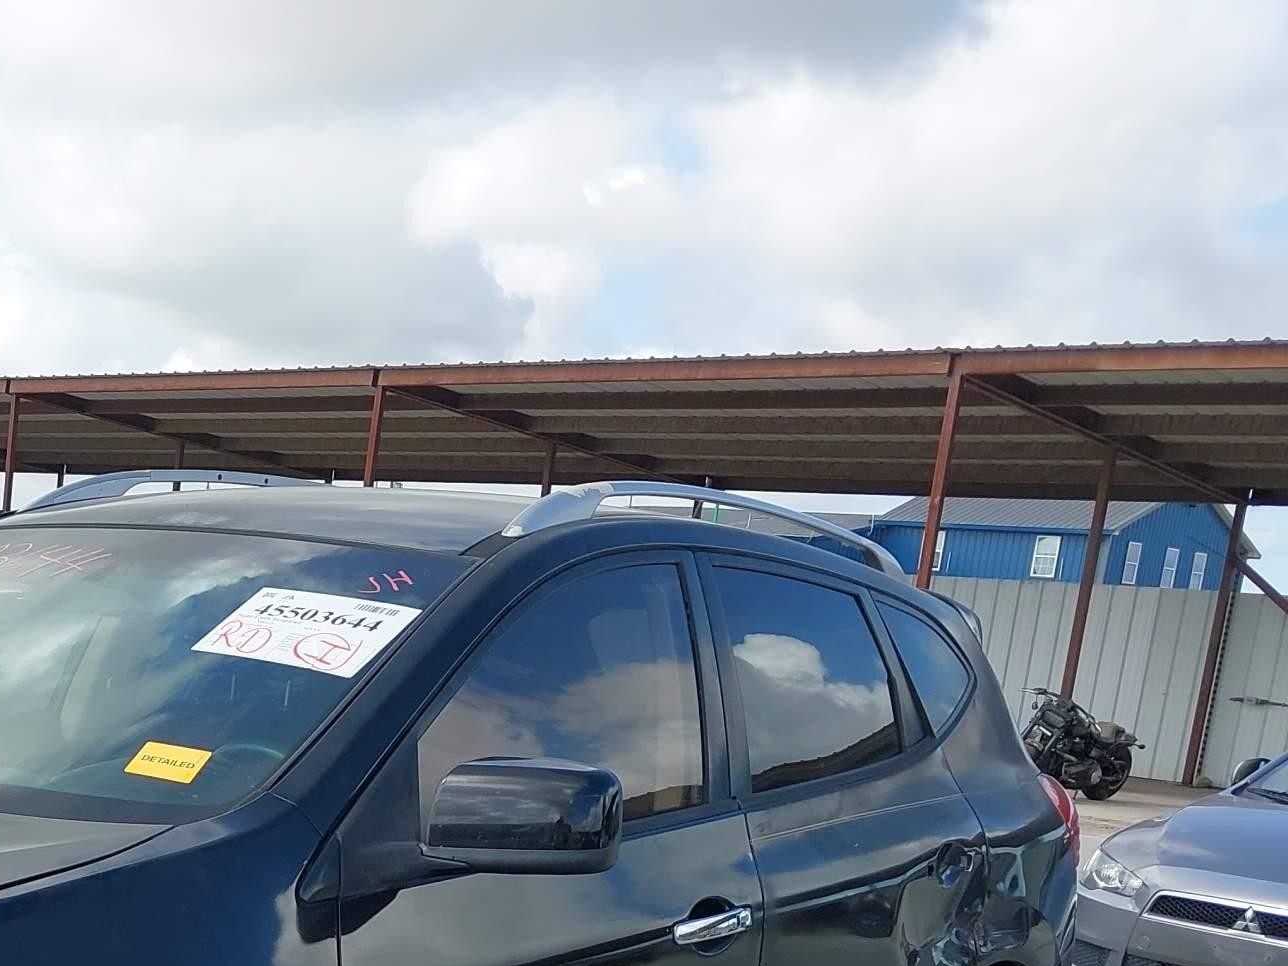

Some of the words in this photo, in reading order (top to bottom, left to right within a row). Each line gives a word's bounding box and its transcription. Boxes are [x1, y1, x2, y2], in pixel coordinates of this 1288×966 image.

[254, 603, 384, 632] 45503644
[211, 620, 272, 654] RD
[141, 754, 196, 769] DETAILED
